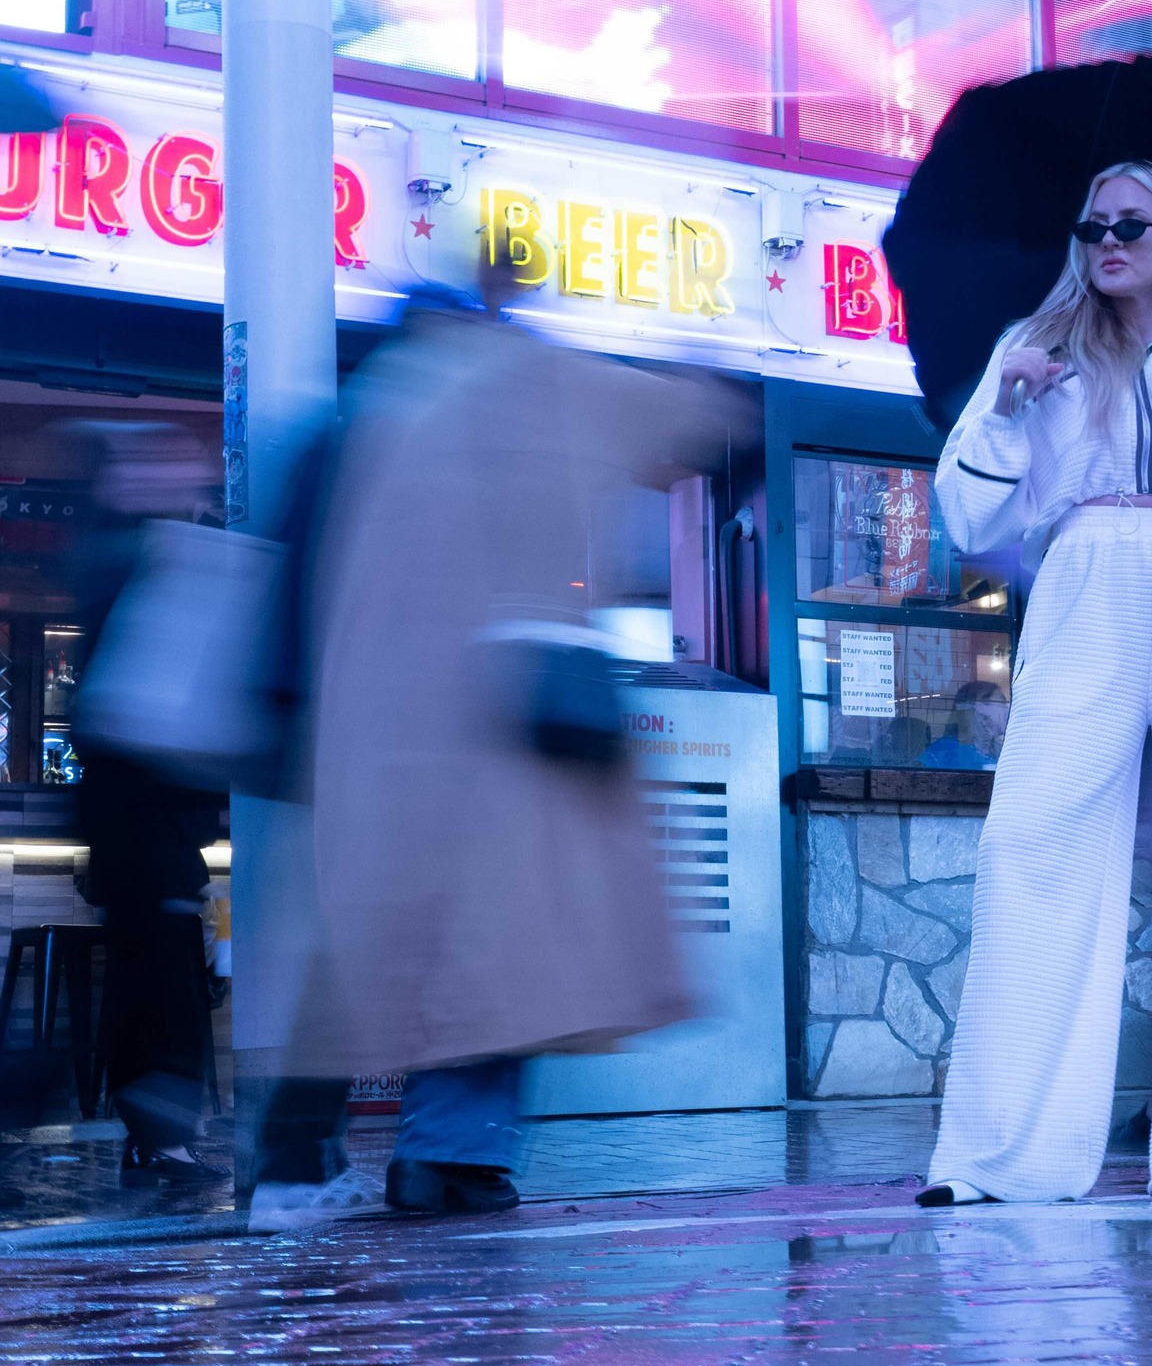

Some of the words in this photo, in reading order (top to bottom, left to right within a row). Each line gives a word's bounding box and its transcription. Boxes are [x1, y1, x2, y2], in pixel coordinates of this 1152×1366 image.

[0, 114, 371, 270] URGR
[480, 185, 736, 316] BEER
[855, 516, 888, 537] Blue
[682, 741, 731, 757] SPIRITS
